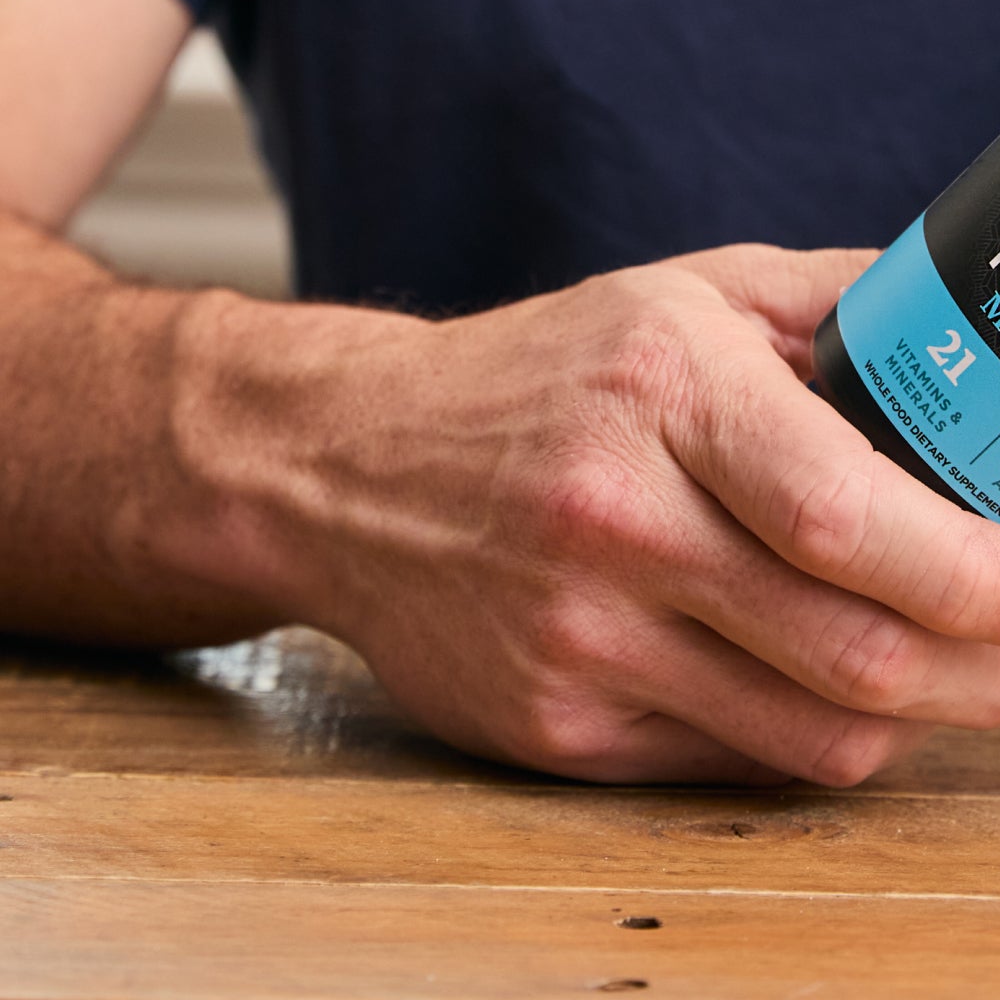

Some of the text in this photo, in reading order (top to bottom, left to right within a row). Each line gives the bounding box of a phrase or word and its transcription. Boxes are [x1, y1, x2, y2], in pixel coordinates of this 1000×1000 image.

[884, 354, 947, 433] MINERALS
[895, 337, 962, 425] VITAMINS &
[926, 329, 976, 387] 21
[864, 359, 890, 398] WHOLE
[886, 396, 912, 426] FOOD
[910, 425, 951, 467] DIETARY
